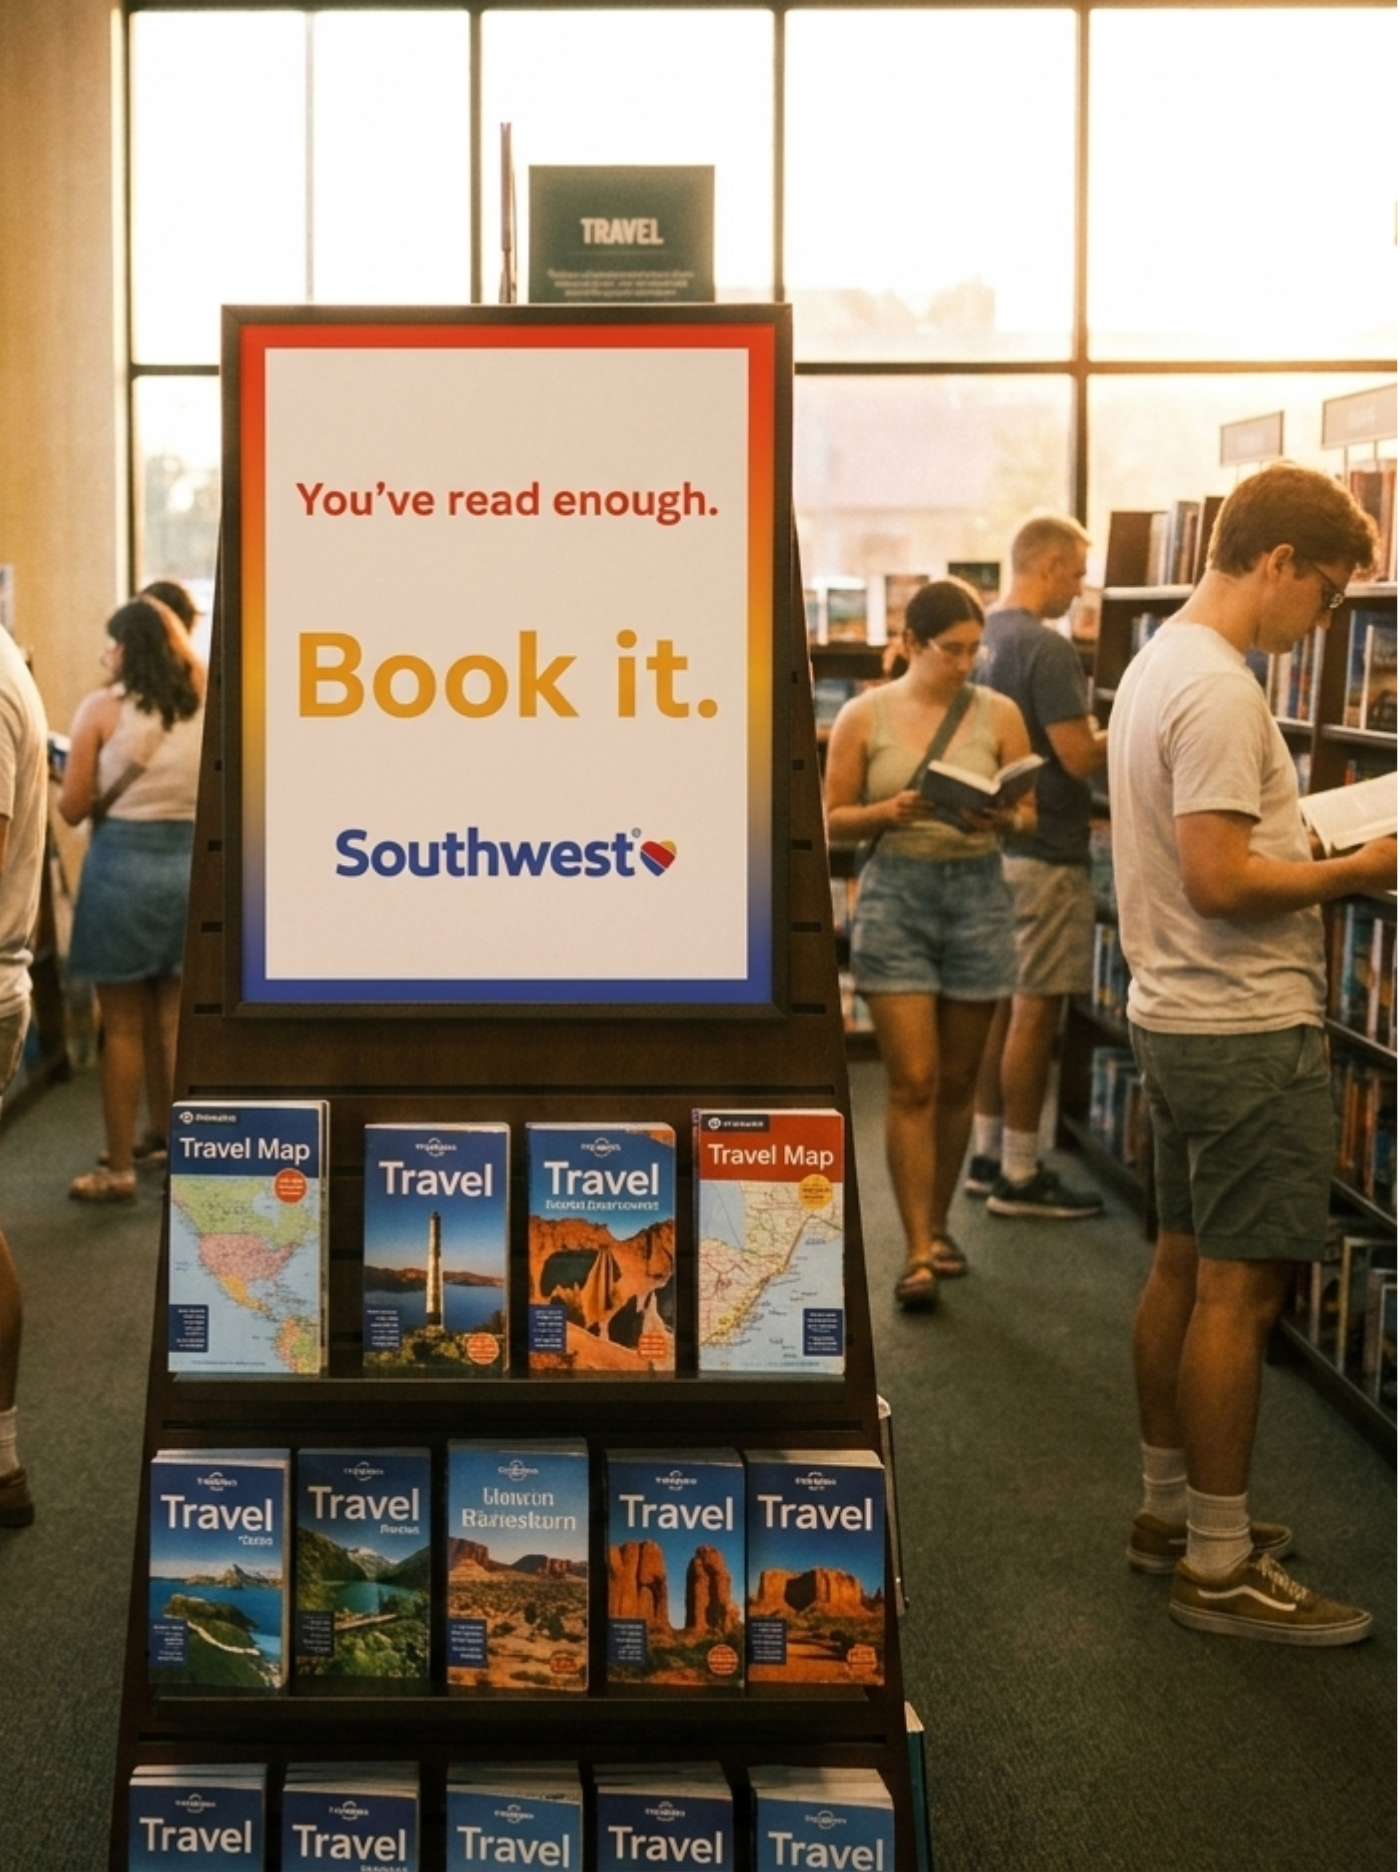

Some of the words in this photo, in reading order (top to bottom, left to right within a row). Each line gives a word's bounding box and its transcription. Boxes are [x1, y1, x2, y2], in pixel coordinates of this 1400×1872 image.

[580, 217, 664, 245] TRAVEL
[296, 481, 435, 516] You’ve
[449, 481, 539, 516] read
[553, 481, 718, 526] enough.
[299, 630, 579, 719] Book
[616, 629, 718, 719] it.
[336, 826, 636, 877] Southwest
[179, 1137, 251, 1159] Travel
[258, 1137, 310, 1166] Map
[707, 1143, 777, 1165] Travel
[784, 1144, 834, 1170] Map
[378, 1161, 492, 1197] Travel
[543, 1161, 659, 1196] Travel
[160, 1494, 273, 1532] Travel
[308, 1486, 420, 1522] Travel
[619, 1494, 734, 1531] Travel
[757, 1495, 872, 1531] Travel
[139, 1817, 252, 1854] Travel
[292, 1824, 406, 1862] Travel
[456, 1826, 570, 1868] Travel
[608, 1826, 723, 1864] Travel
[767, 1831, 884, 1872] Travel
